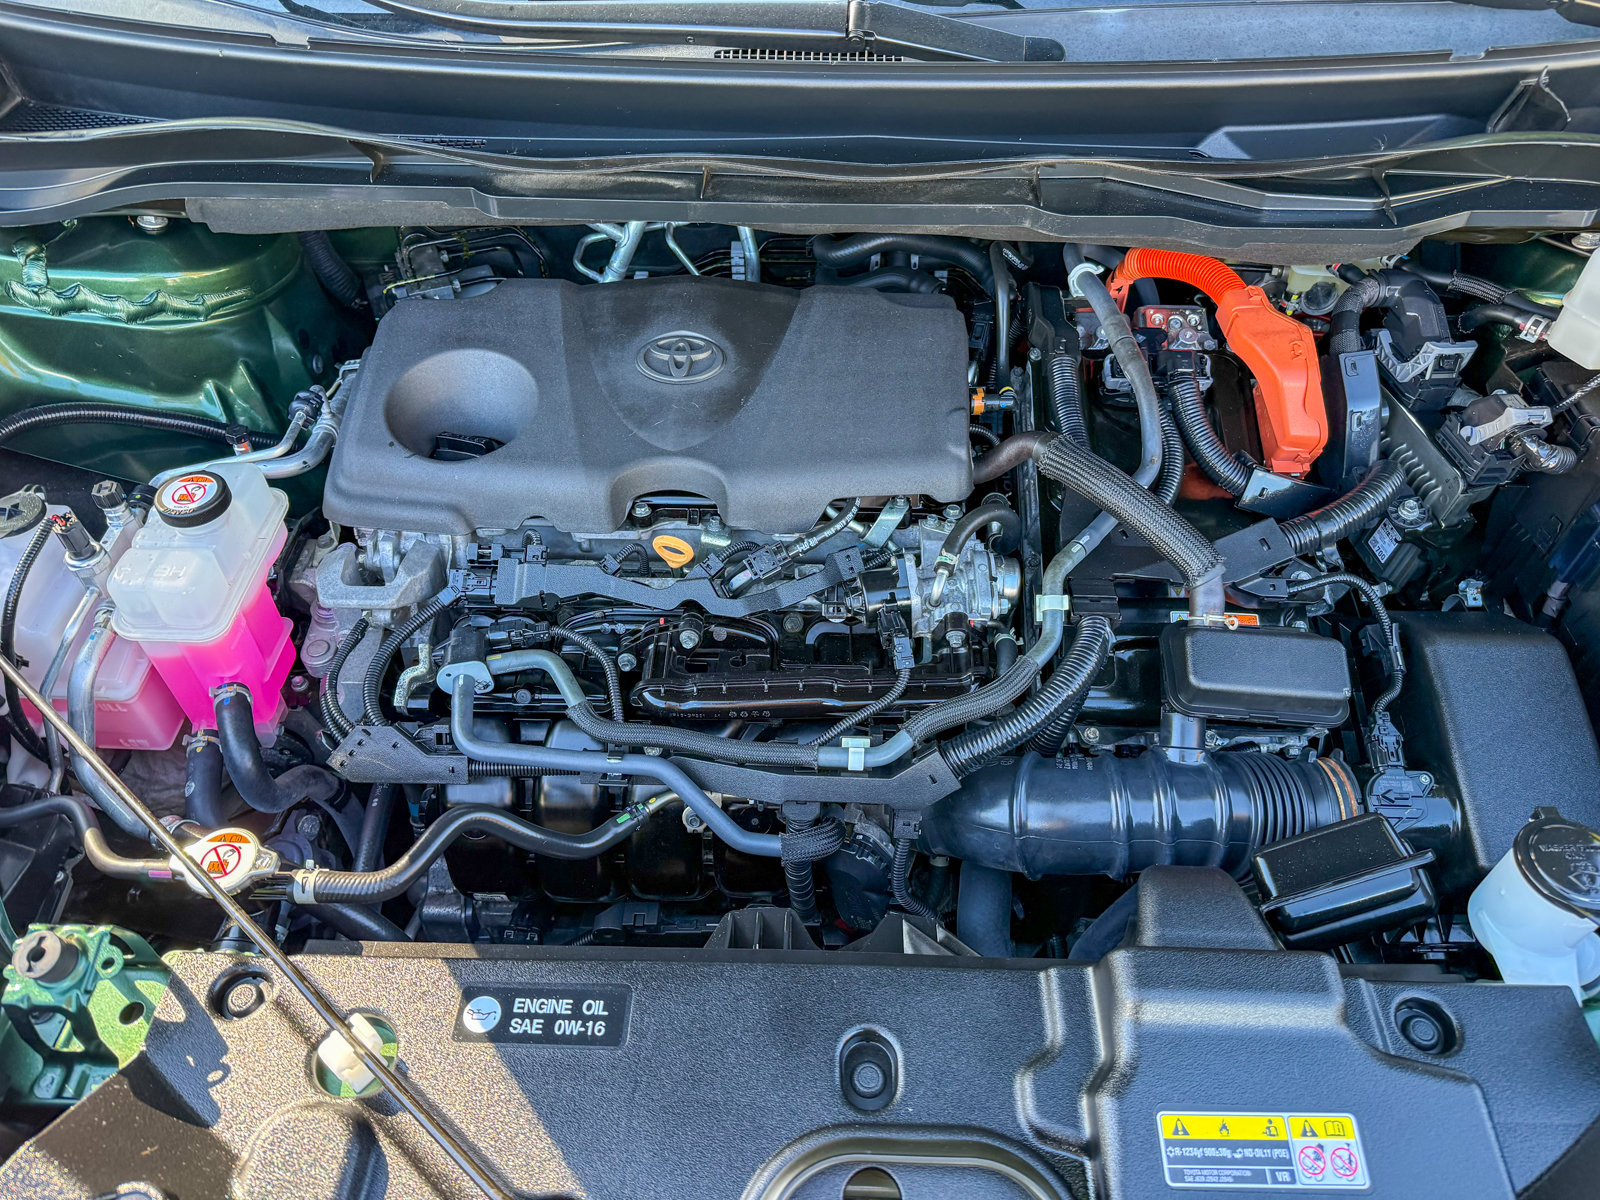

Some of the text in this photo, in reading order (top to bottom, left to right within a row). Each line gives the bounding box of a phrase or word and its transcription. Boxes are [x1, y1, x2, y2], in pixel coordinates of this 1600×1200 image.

[1375, 545, 1386, 561] 700
[95, 703, 128, 712] ULL
[513, 998, 609, 1016] ENGINE OIL
[509, 1018, 606, 1036] SAE 0W-16
[1275, 1171, 1291, 1182] VR
